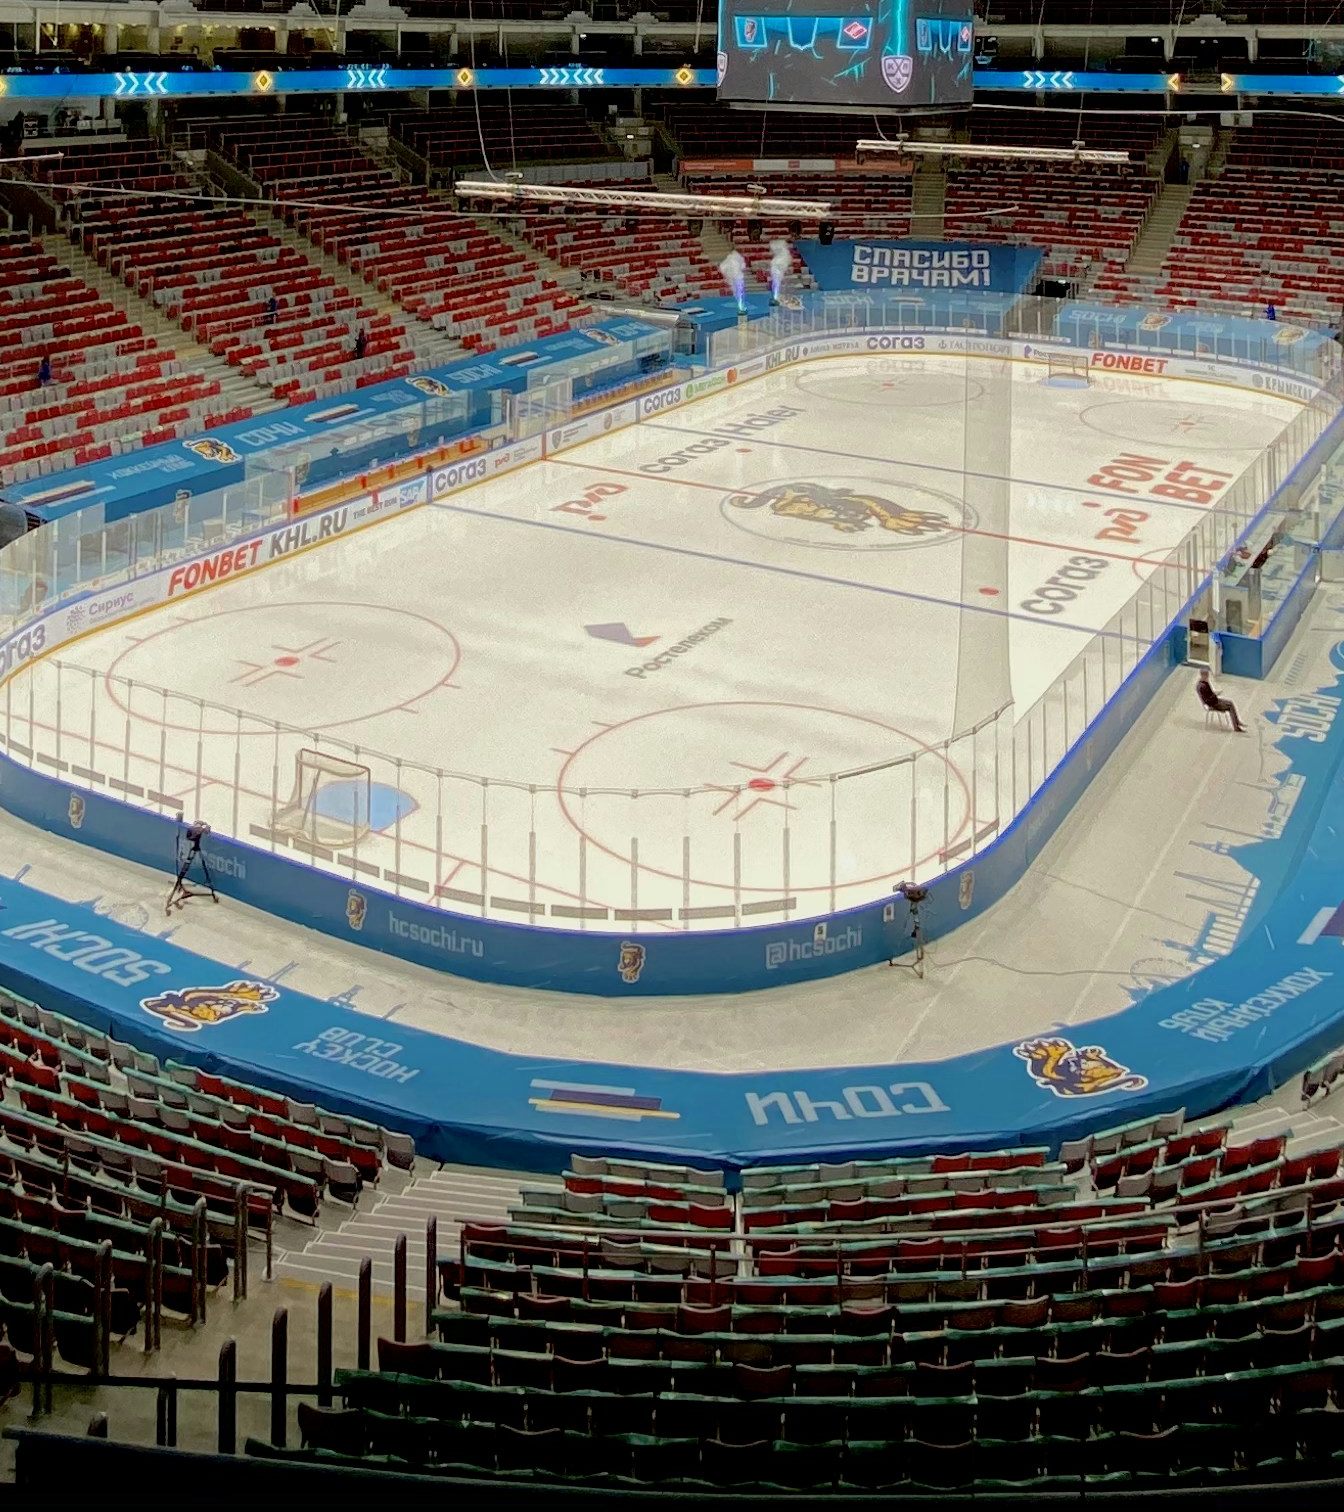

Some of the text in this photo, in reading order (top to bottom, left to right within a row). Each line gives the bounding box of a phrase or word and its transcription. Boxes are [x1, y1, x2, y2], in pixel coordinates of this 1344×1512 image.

[850, 264, 991, 287] ВРАЧАМ!
[853, 244, 991, 269] СПАСИБО
[444, 363, 505, 385] SOCHI
[765, 345, 800, 371] KHL.RU
[1090, 352, 1169, 375] FONBET
[239, 420, 307, 447] СОЧИ
[715, 404, 807, 436] Haier
[1086, 451, 1171, 494] FON
[1149, 460, 1234, 505] BET
[268, 507, 349, 559] KHL.RU
[167, 539, 263, 597] FONBET
[88, 592, 134, 616] Сириус
[624, 616, 734, 680] Ростелеком
[0, 918, 172, 988] SOCHI
[388, 910, 485, 958] hcsochi.ru
[765, 924, 863, 970] @hcsochi
[1157, 997, 1234, 1034] КЛУБ
[1190, 966, 1334, 1044] ХОККЕЙНЫЙ
[291, 1038, 421, 1084] HOCKEY
[317, 1026, 404, 1058] CLUB
[743, 1080, 952, 1127] СОЧИ
